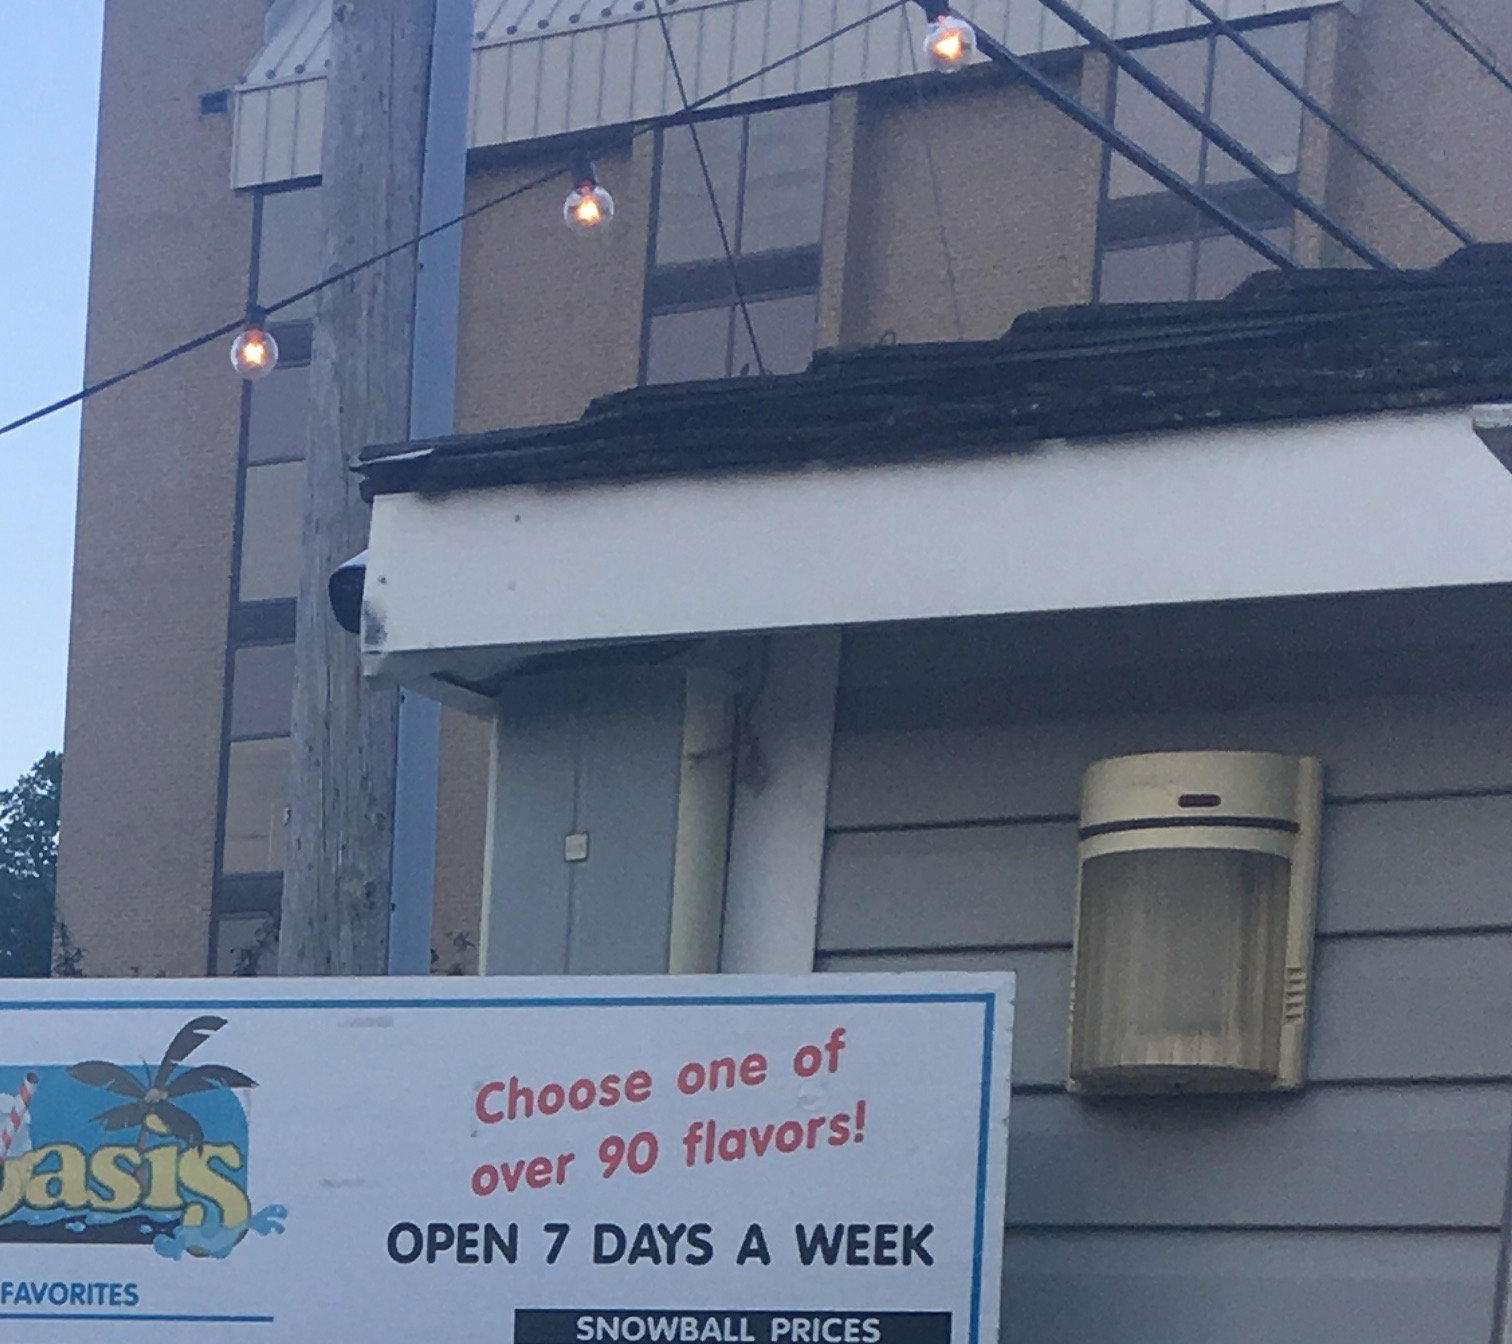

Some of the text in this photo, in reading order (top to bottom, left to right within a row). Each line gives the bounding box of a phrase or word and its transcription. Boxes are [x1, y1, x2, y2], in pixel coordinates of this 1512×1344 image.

[474, 1027, 846, 1124] Choose one of
[471, 1101, 867, 1197] over 90 flavors!
[386, 1221, 935, 1267] OPEN 7 DAYS A WEEK
[0, 1281, 140, 1307] FAVORITES
[576, 1316, 881, 1343] SNOWBALL PRICES
